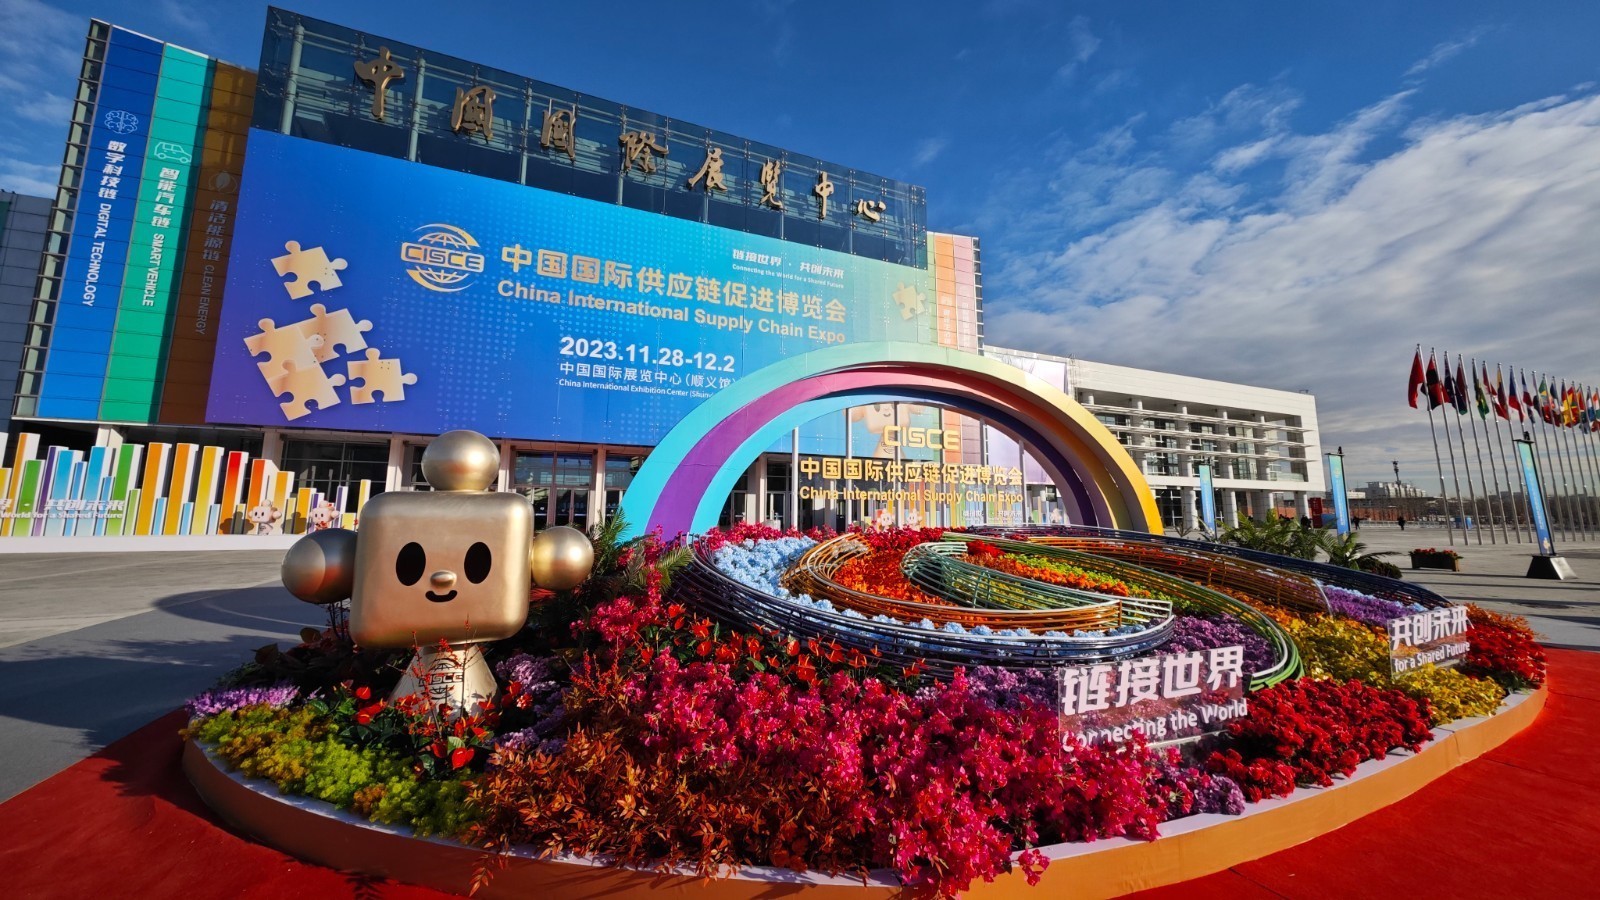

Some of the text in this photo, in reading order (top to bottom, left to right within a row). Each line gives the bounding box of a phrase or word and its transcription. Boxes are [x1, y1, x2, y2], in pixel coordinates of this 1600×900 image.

[82, 140, 127, 307] 数字科技链 DIGITAL TECHNOLOGY
[142, 167, 180, 307] 智能汽车链 SMART VEHICLE
[195, 200, 229, 335] 清洁能源链 CLEAN ENERGY
[405, 245, 481, 270] CISCE
[501, 243, 847, 323] 中国国际供应链促进博览会
[732, 264, 765, 275] Connecting
[765, 269, 775, 277] the
[776, 271, 793, 280] World
[807, 277, 826, 286] Shared
[826, 280, 844, 289] Future
[497, 279, 846, 344] China International Supply Chain Expo
[559, 336, 736, 373] 2023.11.28-12.2
[559, 378, 581, 388] China
[582, 380, 630, 392] International
[630, 384, 665, 396] Exhibition
[666, 387, 689, 397] Center
[884, 425, 960, 451] CISCE
[800, 457, 1023, 486] 中国国际供应链促进博览会
[800, 486, 1023, 506] China International Supply Chain Expo
[0, 511, 31, 519] World
[32, 511, 48, 519] for
[58, 511, 91, 519] Shared
[1391, 606, 1470, 651] 共创未来
[1394, 641, 1471, 673] for a Shared Future
[1061, 646, 1244, 716] 链接世界
[1170, 709, 1198, 730] the
[1201, 698, 1248, 724] World
